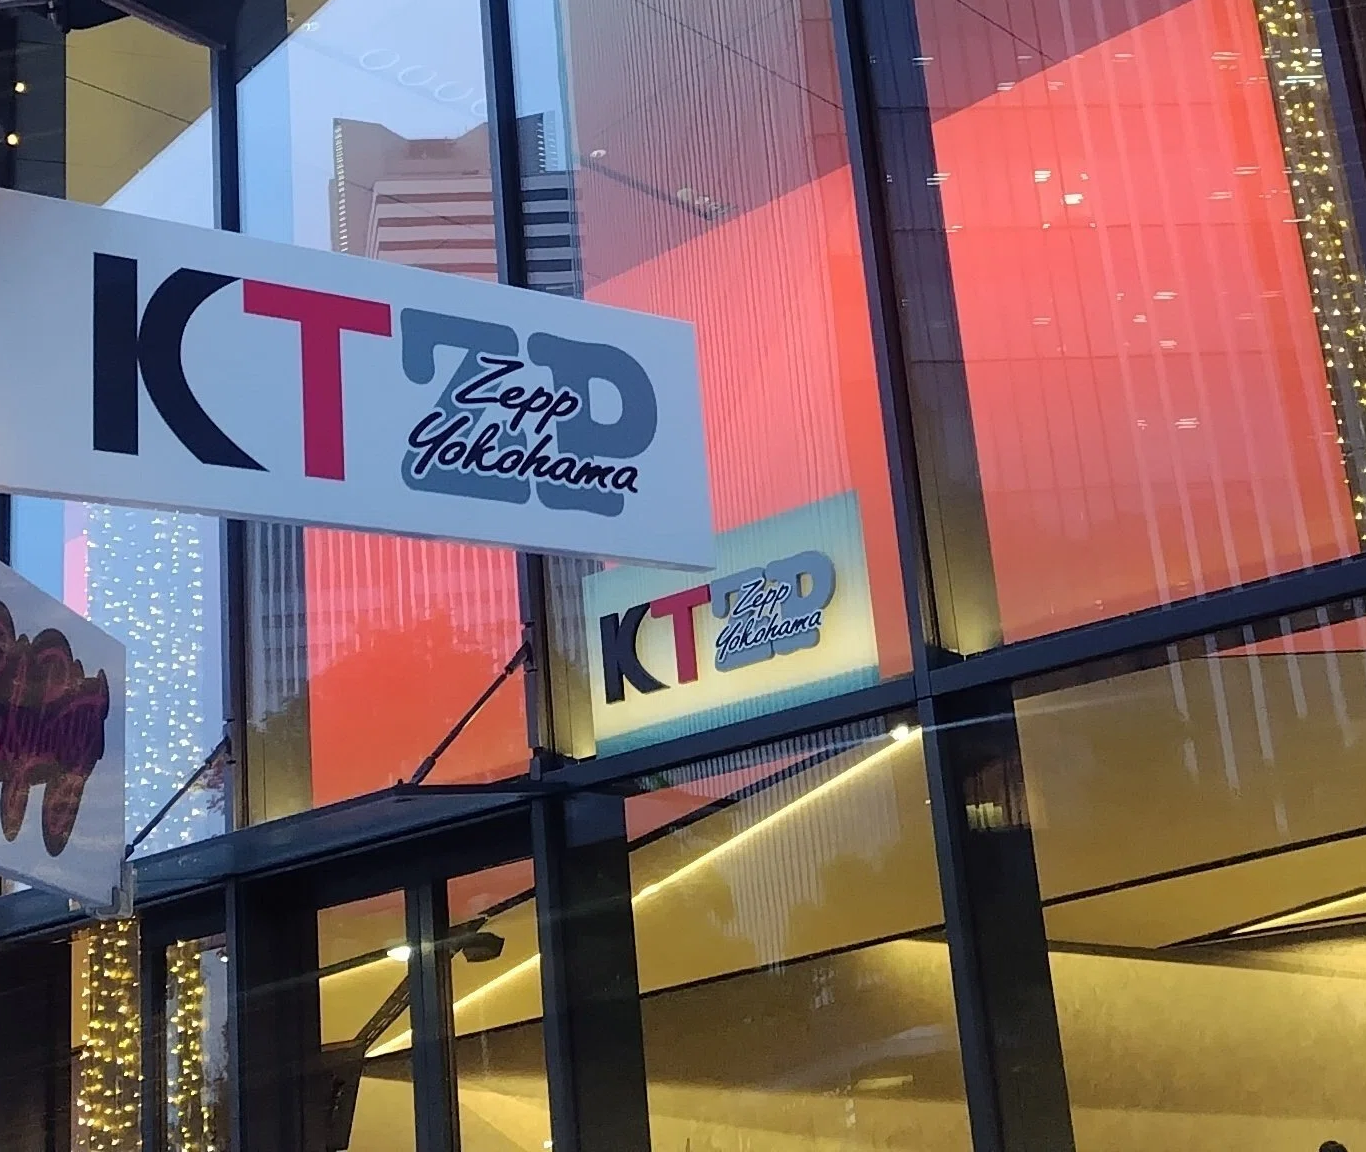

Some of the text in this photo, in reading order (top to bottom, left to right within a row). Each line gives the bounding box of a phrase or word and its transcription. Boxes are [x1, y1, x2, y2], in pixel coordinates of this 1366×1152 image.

[92, 251, 393, 482] KT
[455, 355, 579, 434] Zepp
[408, 411, 639, 494] Yokohama
[715, 609, 822, 662] Yokohama
[732, 577, 790, 618] Zepp
[599, 583, 712, 704] KT
